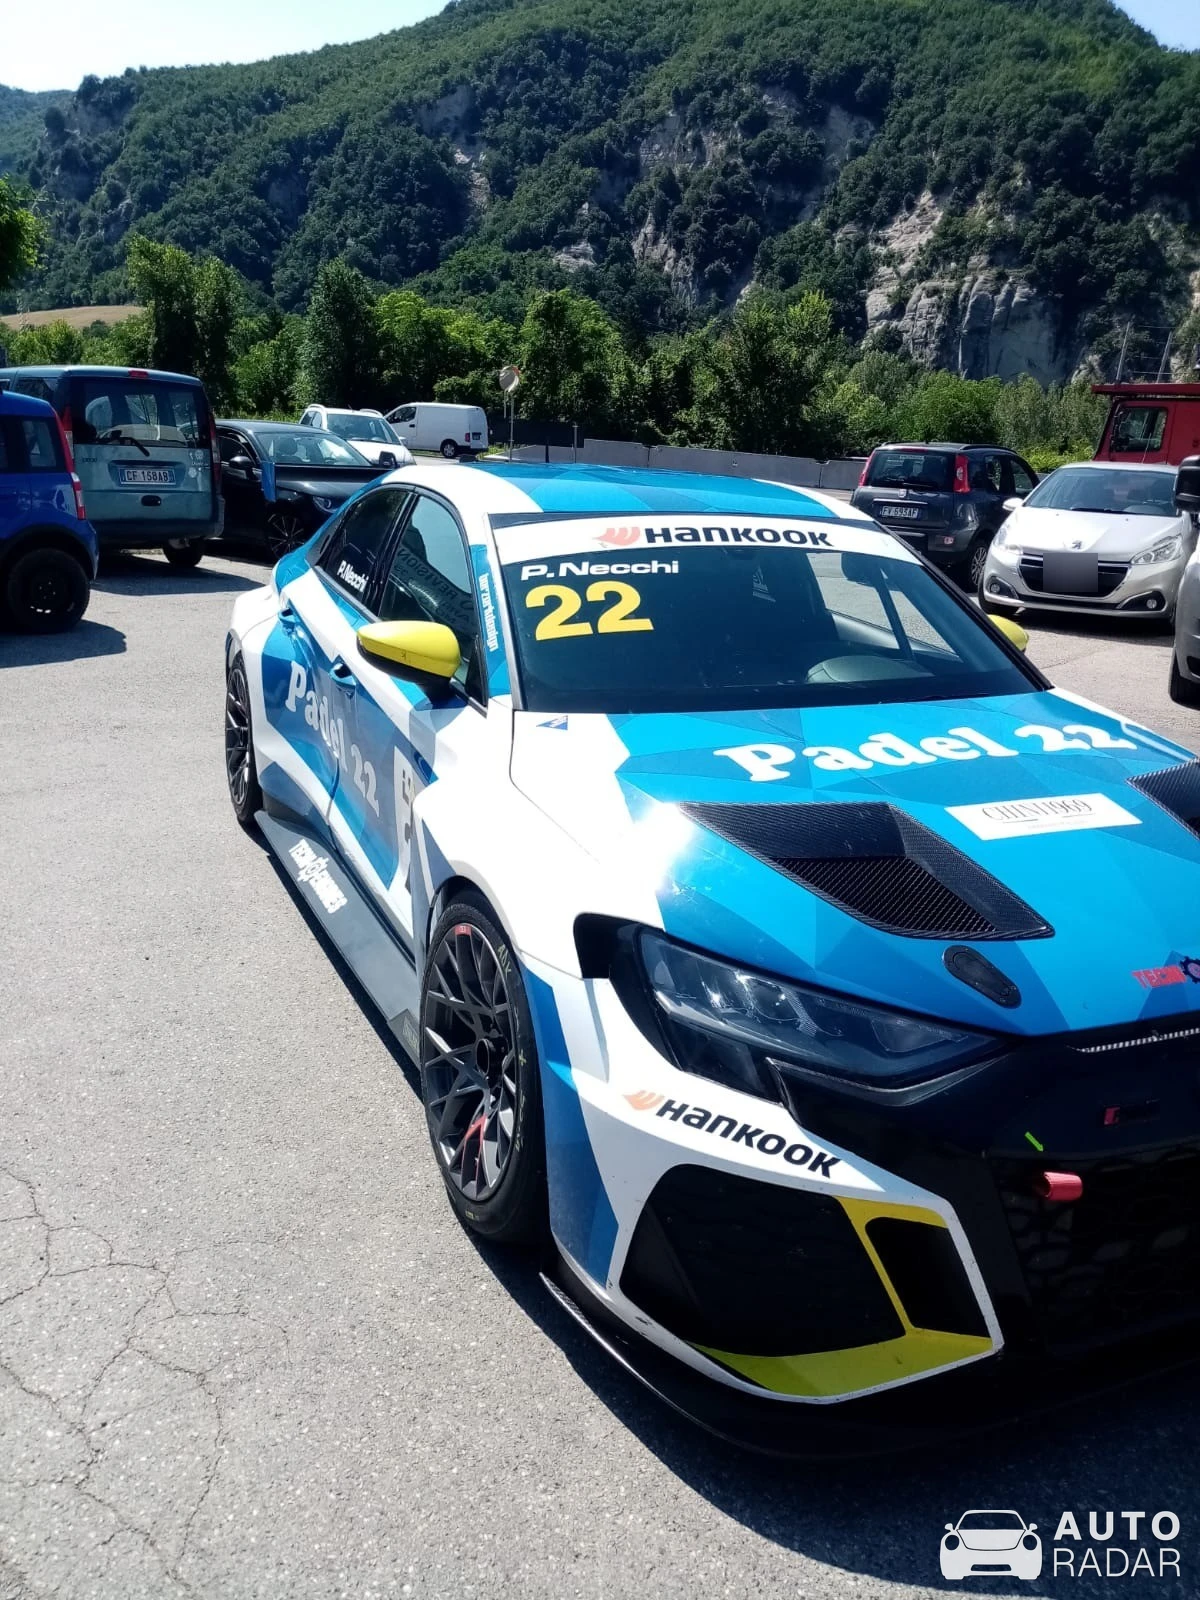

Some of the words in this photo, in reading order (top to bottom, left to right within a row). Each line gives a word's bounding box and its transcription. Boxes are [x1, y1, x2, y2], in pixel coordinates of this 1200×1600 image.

[525, 580, 654, 641] 22
[284, 660, 348, 772] Padel
[351, 743, 380, 818] 22
[713, 726, 1019, 782] Padel
[1014, 724, 1138, 752] 22
